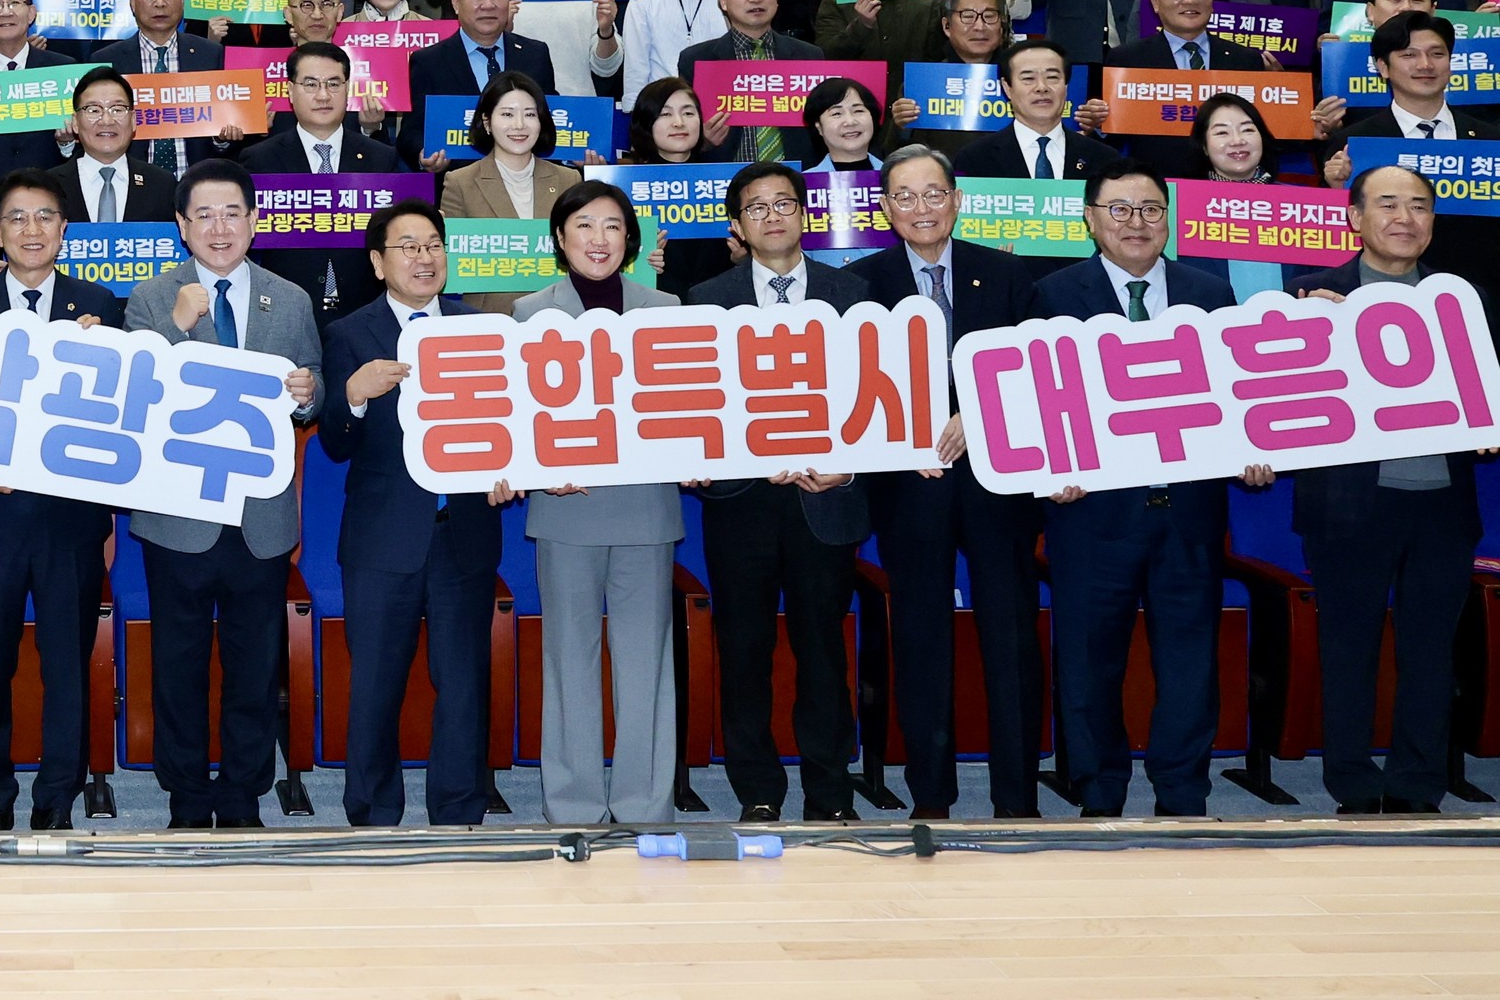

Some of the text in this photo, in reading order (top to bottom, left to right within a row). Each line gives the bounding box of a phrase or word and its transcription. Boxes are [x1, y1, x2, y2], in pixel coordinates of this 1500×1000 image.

[7, 81, 58, 100] 새로운
[733, 74, 784, 91] 산업은
[717, 95, 767, 112] 기회는
[256, 189, 332, 209] 대한민국
[1206, 198, 1347, 225] 산업은 커지고
[1184, 220, 1251, 242] 기회는
[115, 239, 180, 258] 첫걸음,
[972, 293, 1495, 474] 대부흥의
[417, 315, 933, 474] 통합특별시
